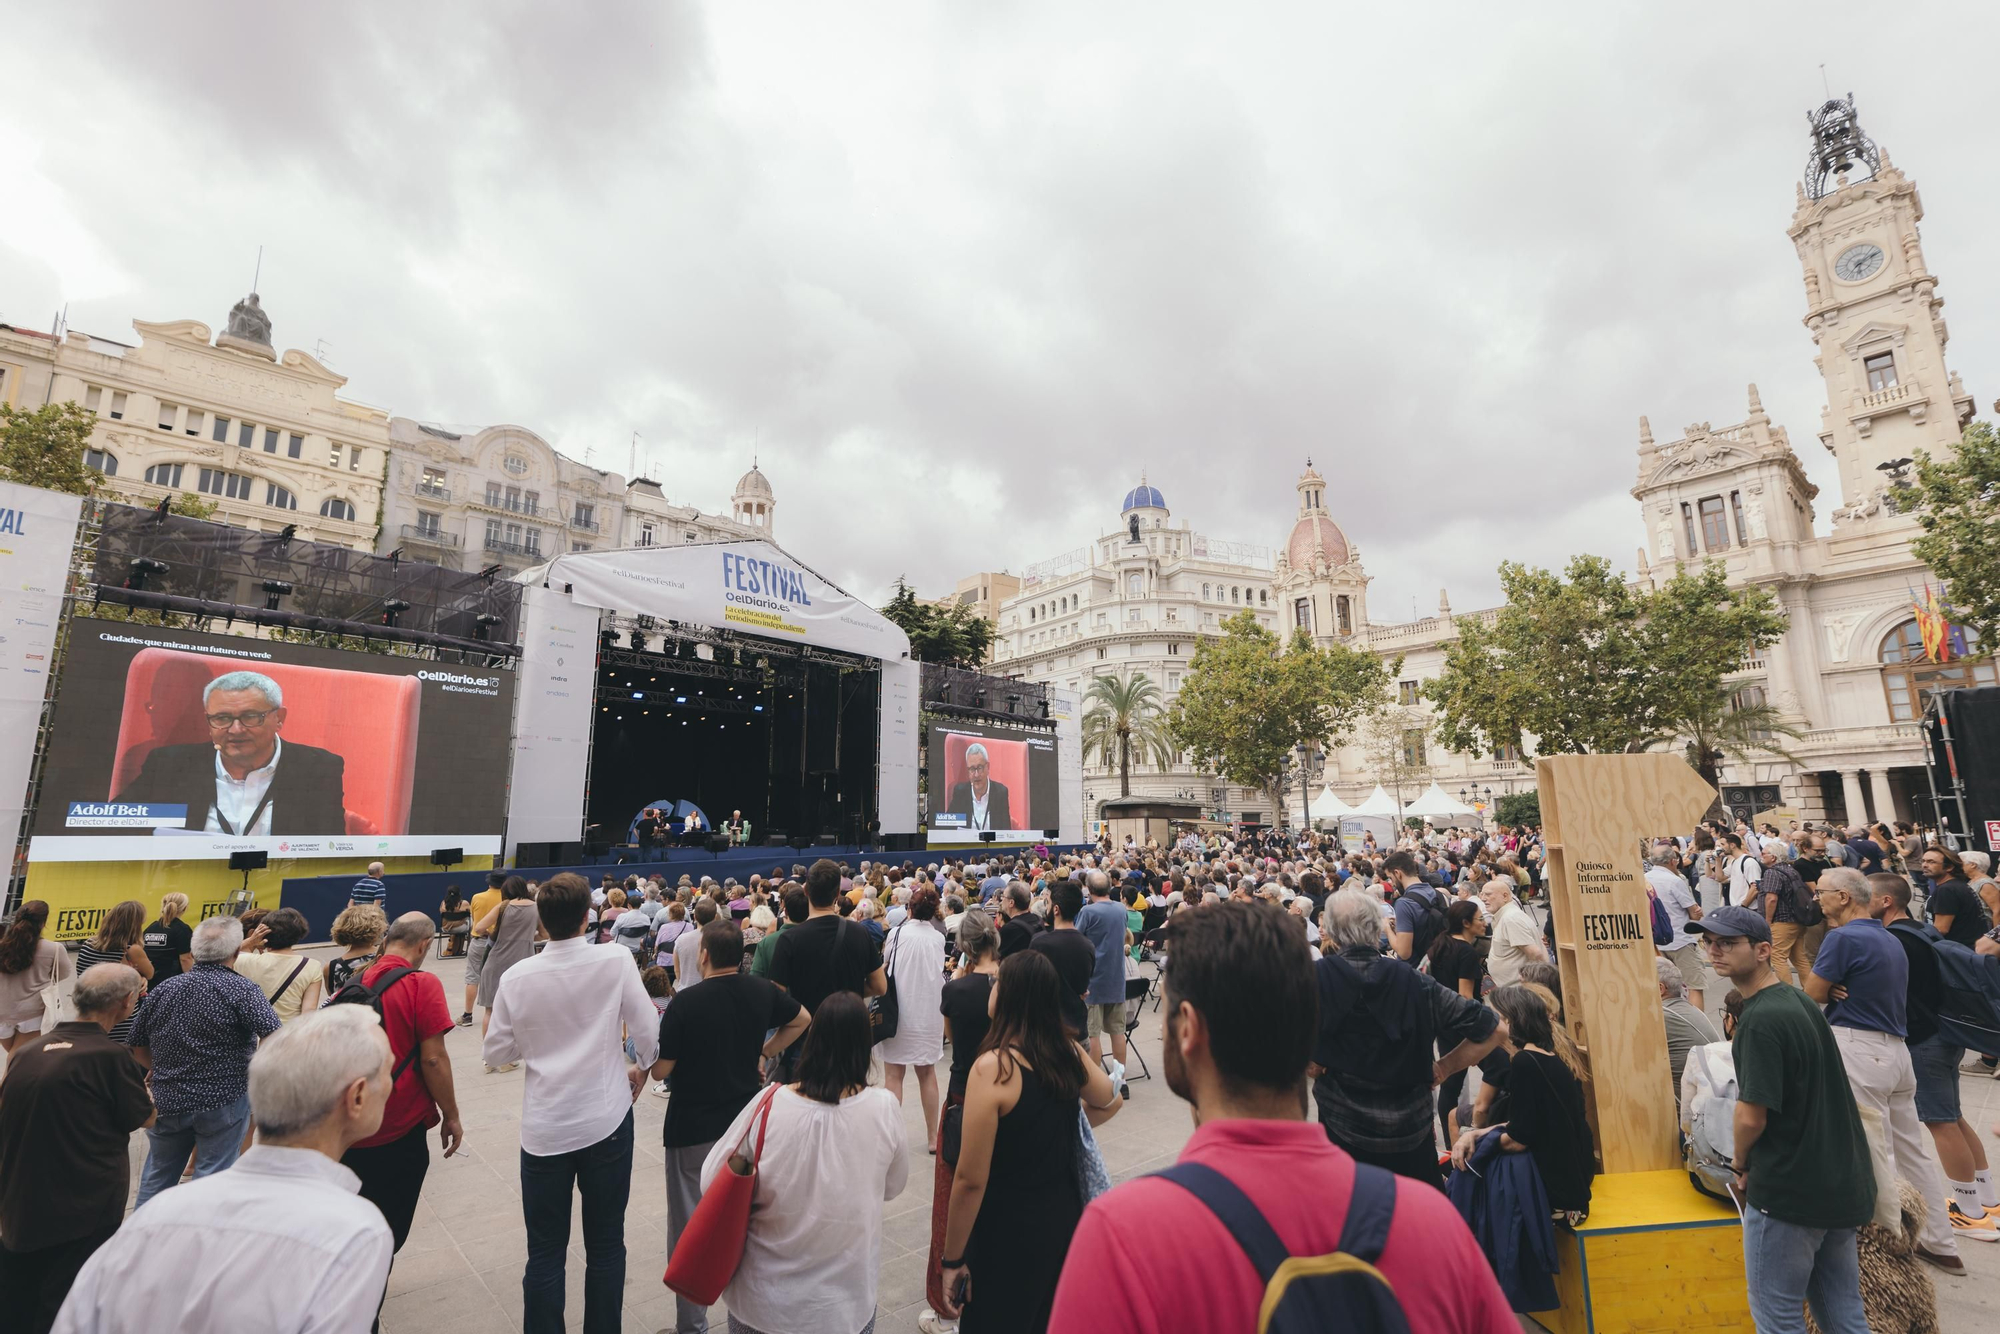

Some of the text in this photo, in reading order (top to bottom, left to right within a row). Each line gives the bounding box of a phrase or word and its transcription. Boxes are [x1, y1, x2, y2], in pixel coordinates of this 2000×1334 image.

[612, 569, 685, 589] #elDiarioesFestival
[722, 552, 811, 606] FESTIVAL
[725, 613, 806, 634] periodismo independiente
[99, 633, 144, 645] Ciudades
[144, 639, 162, 648] que
[162, 641, 190, 650] miran
[209, 645, 237, 655] futuro
[249, 651, 272, 659] verde
[442, 684, 498, 696] #elDiarioesFestival
[70, 803, 149, 816] Adolf Belt
[69, 818, 149, 826] Director de elDiari
[1576, 861, 1613, 872] Quiosco
[1577, 872, 1633, 882] Información
[1578, 884, 1611, 894] Tienda
[1583, 913, 1644, 941] FESTIVAL
